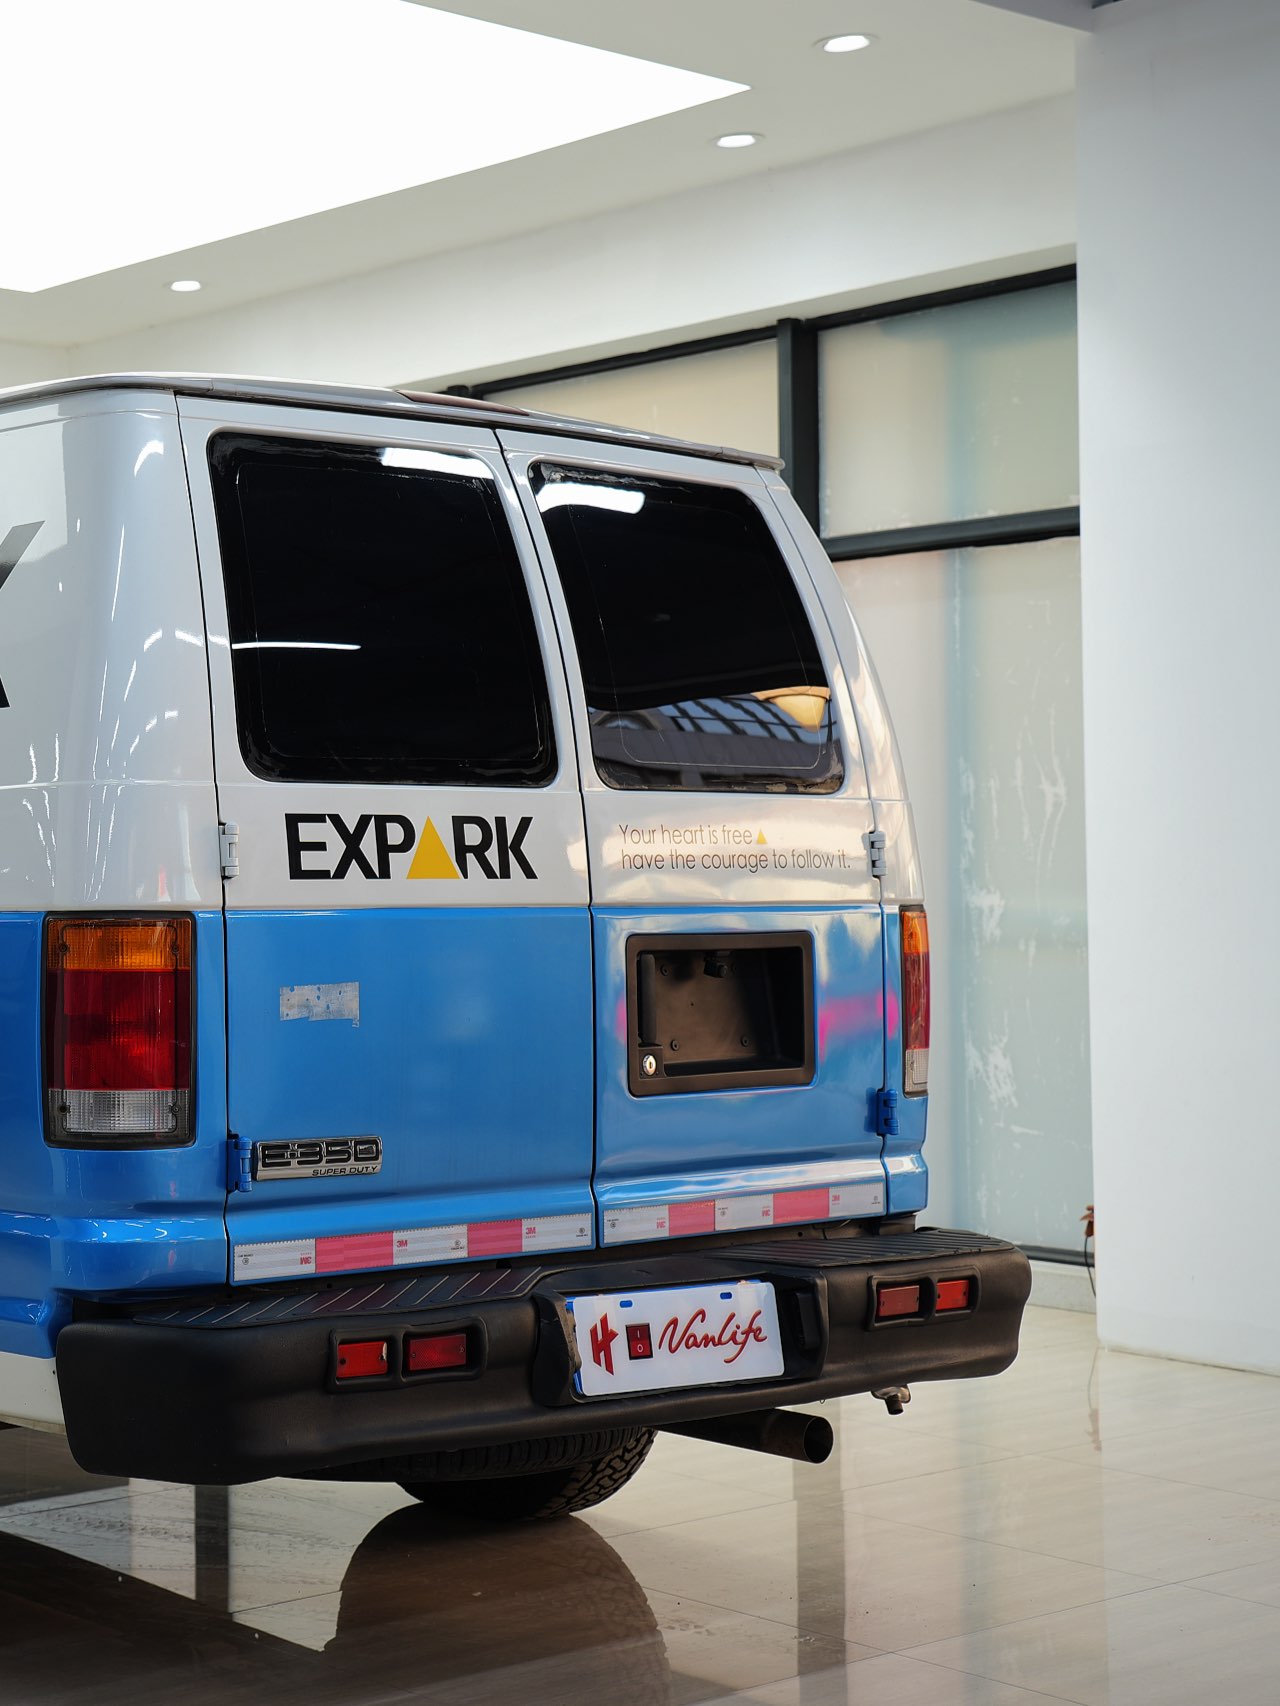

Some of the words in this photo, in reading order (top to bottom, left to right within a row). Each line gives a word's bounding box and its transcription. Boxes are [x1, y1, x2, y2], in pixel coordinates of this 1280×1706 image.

[619, 824, 656, 845] Your
[661, 824, 704, 845] heart
[708, 825, 719, 845] is
[721, 824, 753, 845] free
[622, 849, 665, 870] have
[669, 849, 696, 870] the
[701, 853, 769, 873] courage
[772, 849, 788, 869] to
[791, 849, 835, 869] follow
[838, 850, 851, 869] it.
[312, 1167, 346, 1177] SUPER
[349, 1165, 378, 1174] DUTY
[525, 1227, 536, 1235] 3M
[396, 1239, 408, 1248] 3M
[300, 1256, 312, 1265] 3M
